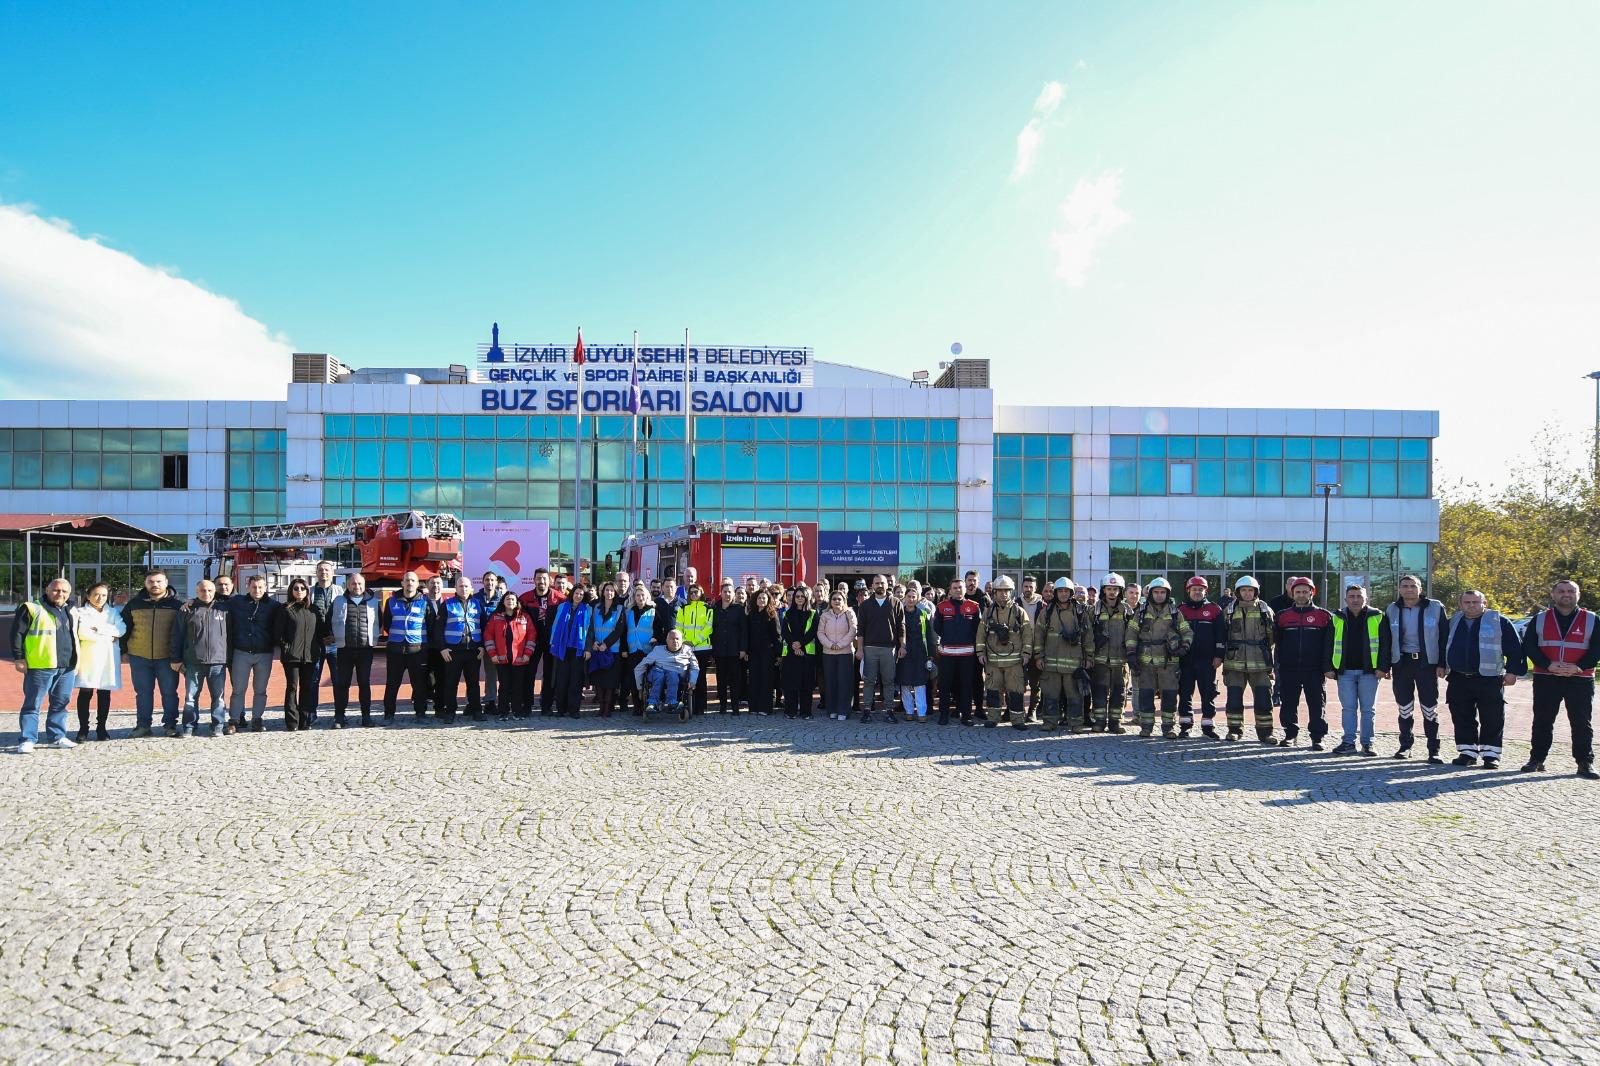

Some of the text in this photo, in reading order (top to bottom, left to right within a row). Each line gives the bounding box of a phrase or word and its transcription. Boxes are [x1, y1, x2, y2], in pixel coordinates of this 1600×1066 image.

[515, 343, 807, 367] İZMİR ÜYÜKŞEHİR BELEDİYESİ
[489, 366, 556, 384] GENÇLİK
[563, 372, 578, 382] ve
[584, 368, 629, 382] SPOR
[704, 368, 801, 386] BAŞKANLIĞI
[481, 388, 537, 411] BUZ
[691, 390, 803, 413] SALONU
[726, 534, 771, 543] İZMİR İTFAİYESİ
